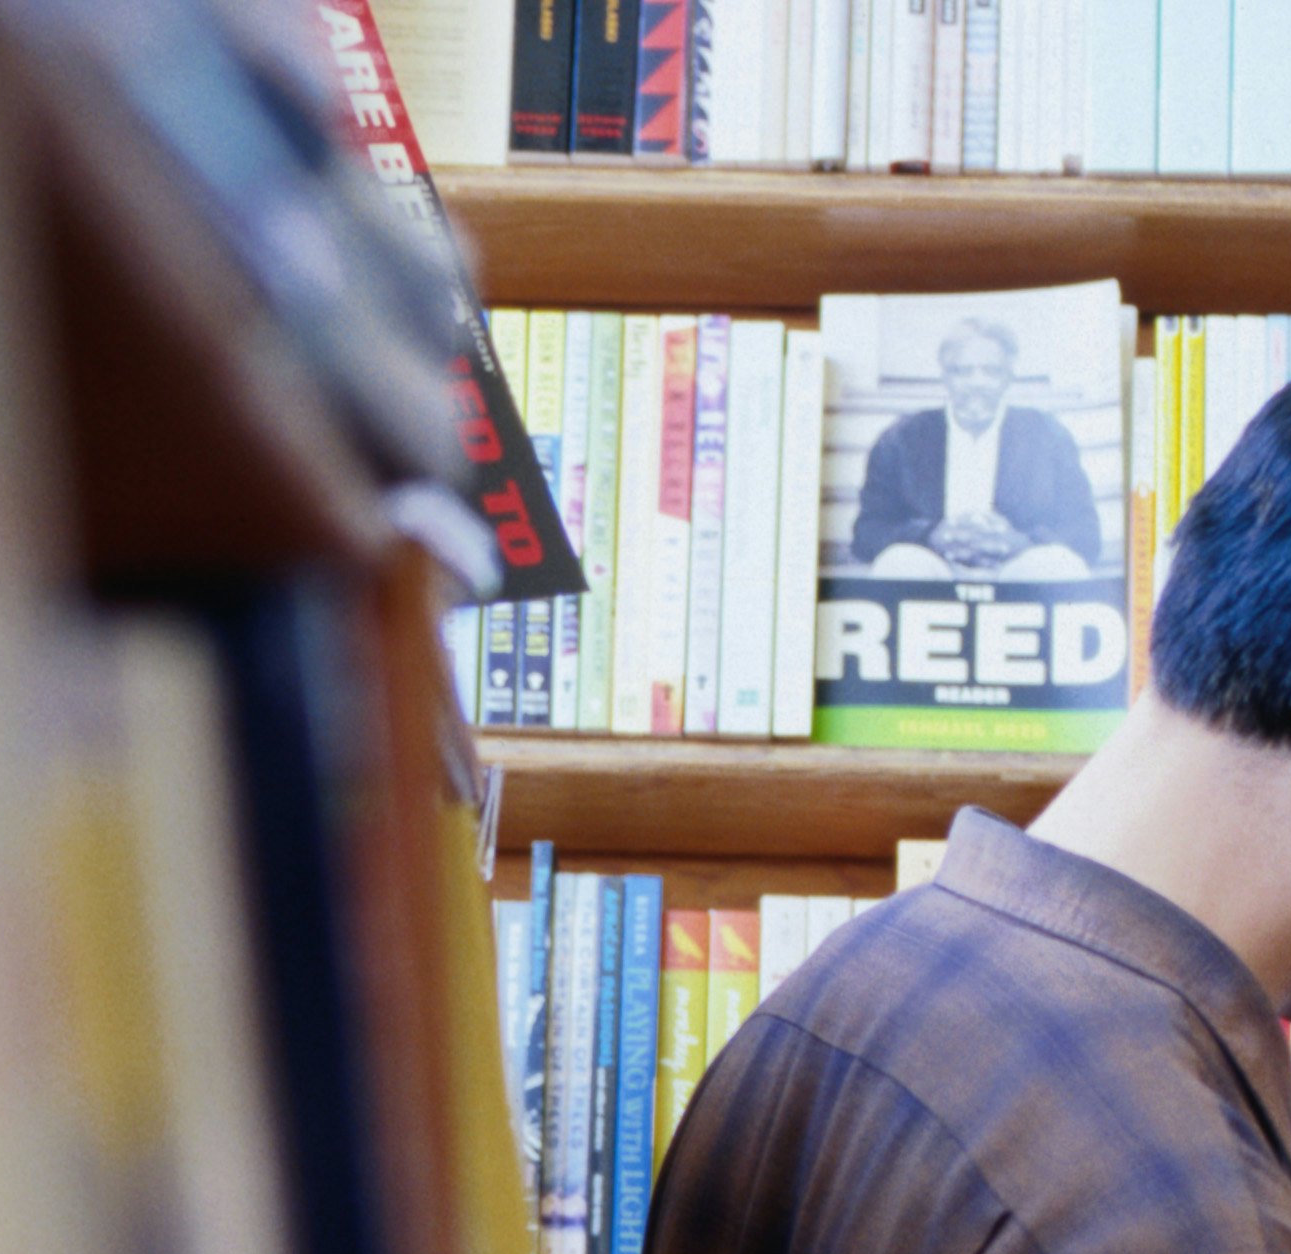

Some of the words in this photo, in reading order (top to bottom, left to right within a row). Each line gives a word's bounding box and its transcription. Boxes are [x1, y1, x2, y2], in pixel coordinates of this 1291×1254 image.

[318, 4, 396, 128] ARE
[483, 478, 545, 568] TO
[954, 582, 995, 602] THE
[815, 600, 1127, 688] REED
[934, 684, 1010, 704] READER
[633, 895, 649, 956] RIVERA
[623, 966, 652, 1091] PLAYING
[619, 1096, 646, 1163] WITH
[618, 1168, 646, 1254] LIGHT
